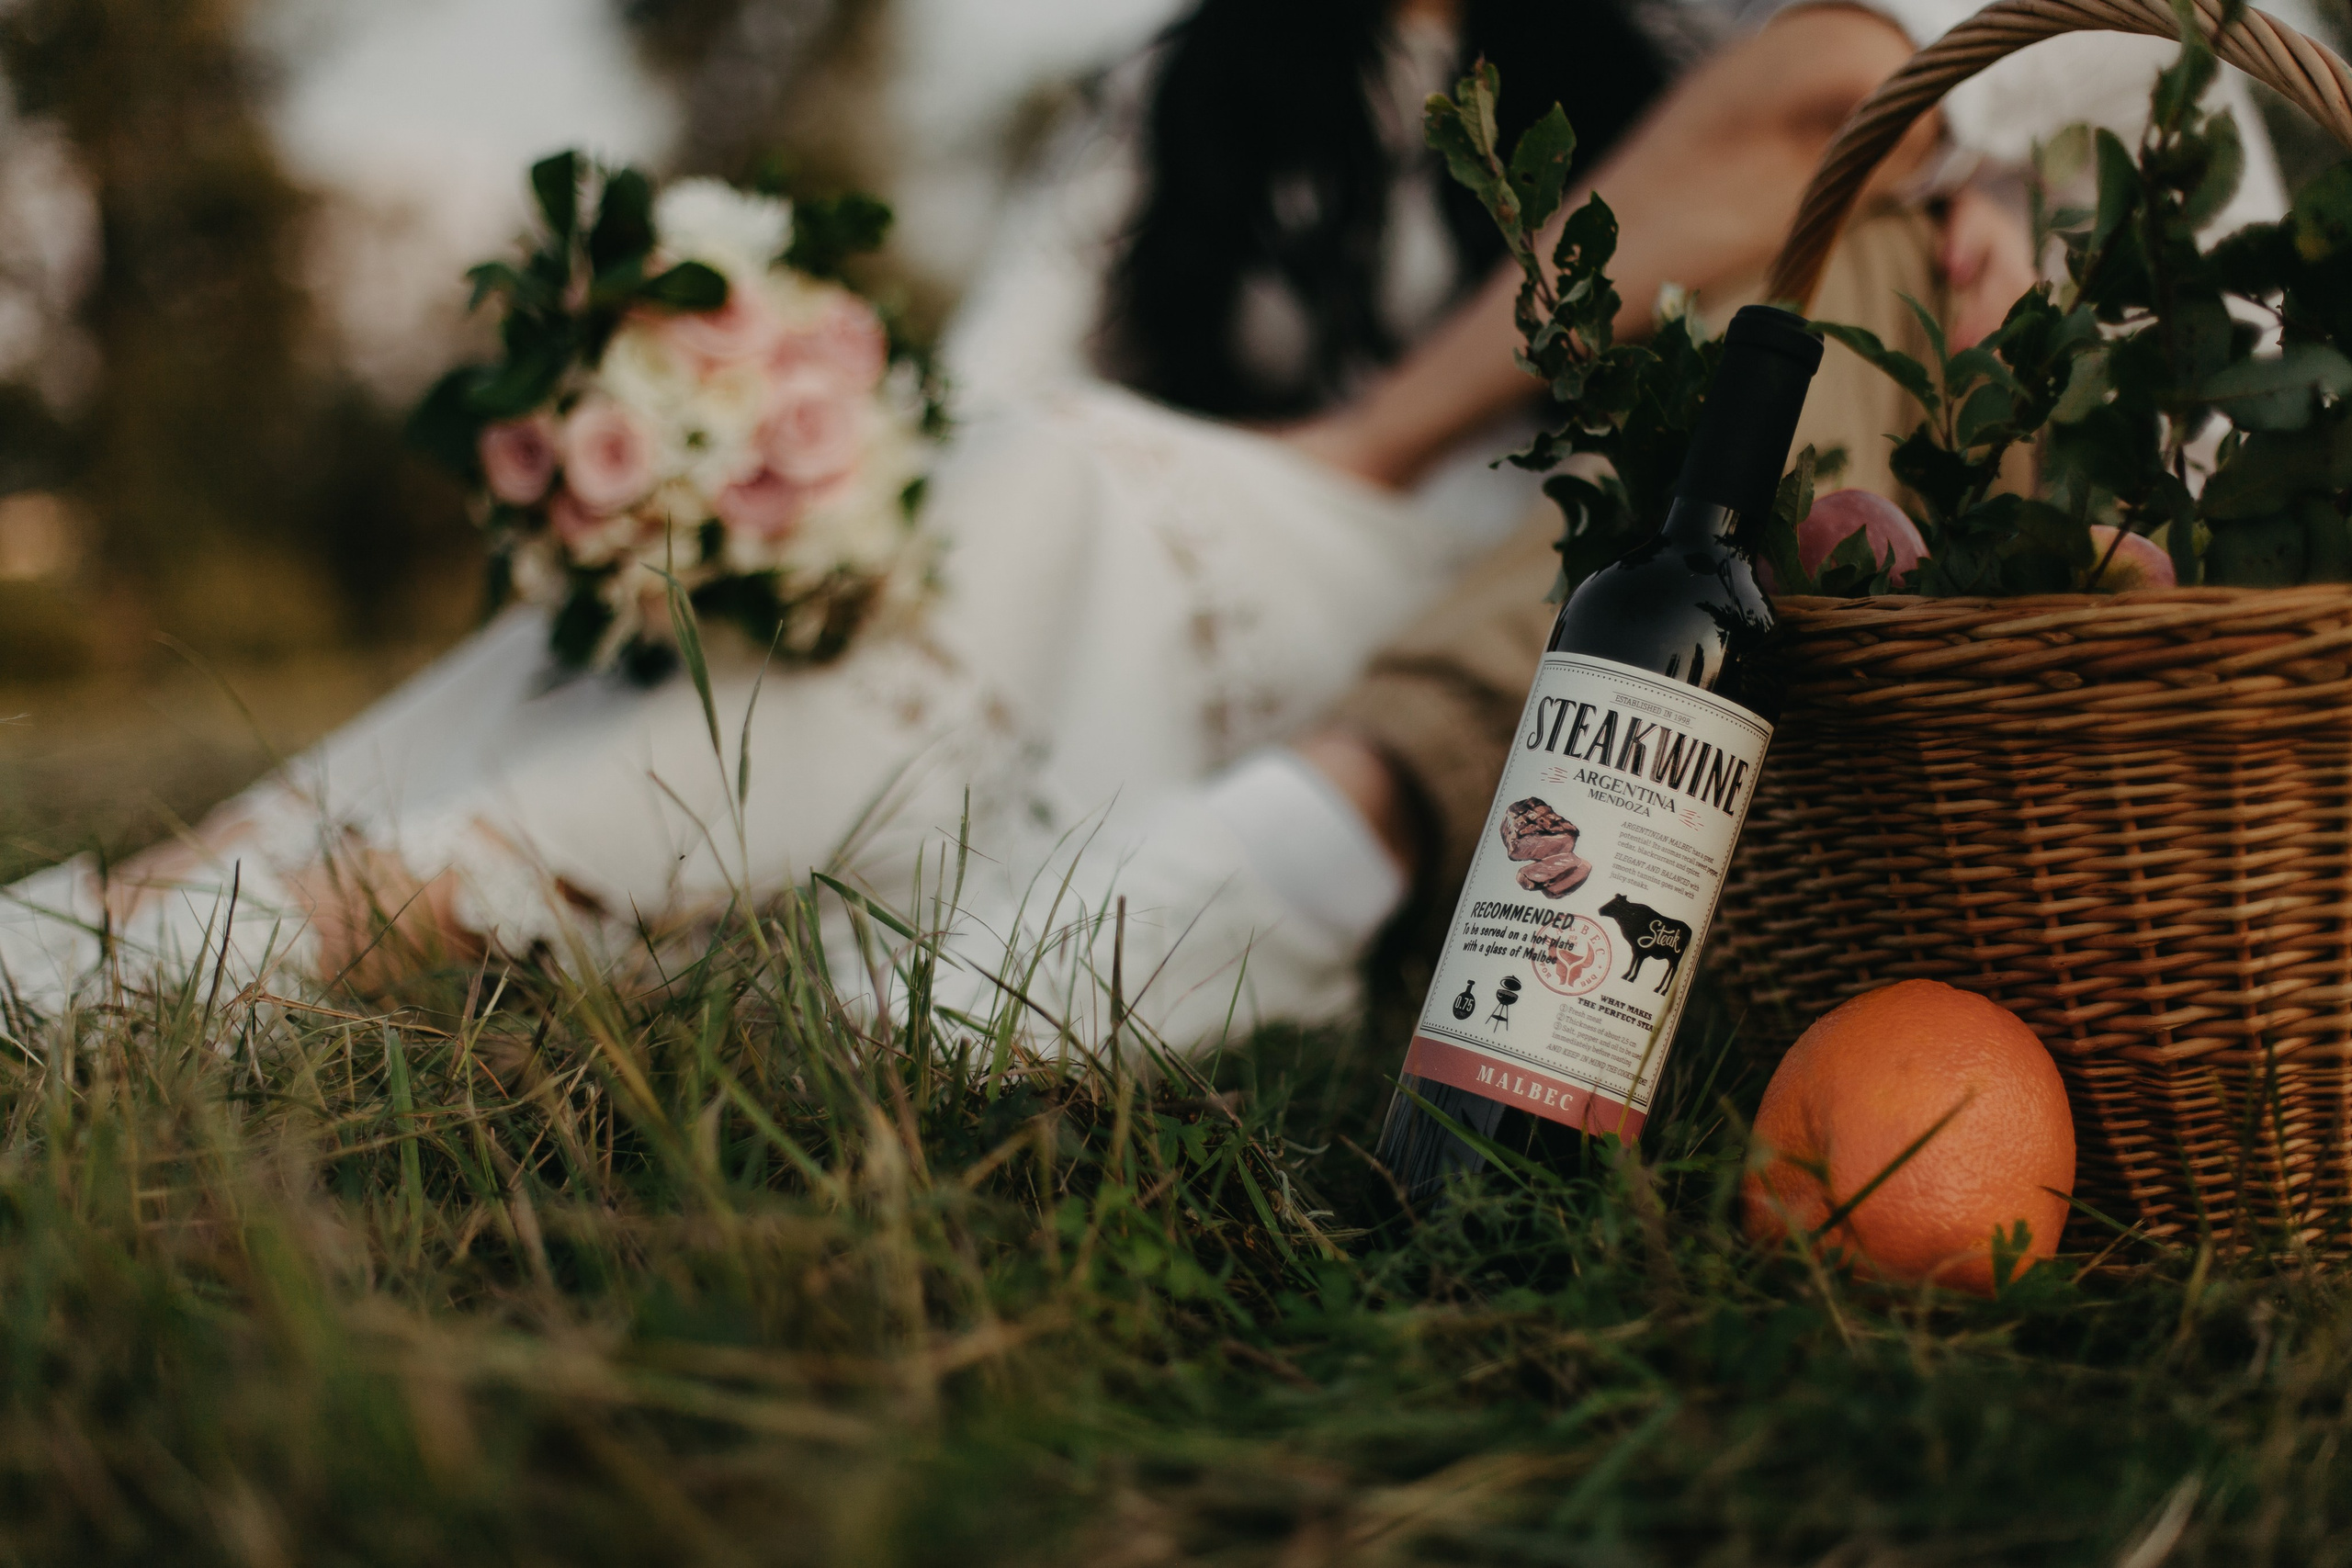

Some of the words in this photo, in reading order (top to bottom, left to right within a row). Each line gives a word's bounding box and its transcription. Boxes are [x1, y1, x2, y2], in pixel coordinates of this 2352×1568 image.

[1615, 694, 1662, 716] ESTABLISHED
[1663, 710, 1672, 718] IN
[1674, 713, 1690, 726] 1998
[1573, 768, 1676, 813] ARGENTINA
[1588, 788, 1651, 818] MENDOZA
[1619, 831, 1652, 847] potential!
[1652, 841, 1661, 851] Its
[1661, 847, 1681, 859] aromas
[1681, 852, 1696, 865] recall
[1621, 821, 1669, 843] ARGENTINIAN
[1668, 838, 1692, 853] MALBEC
[1617, 840, 1635, 852] cedar,
[1637, 846, 1676, 867] blackcurrant
[1676, 861, 1686, 871] and
[1609, 872, 1627, 884] juicy
[1626, 878, 1649, 891] steaks.
[1611, 863, 1636, 876] smooth
[1636, 871, 1661, 885] tannins
[1661, 881, 1673, 890] goes
[1673, 885, 1685, 896] well
[1684, 889, 1695, 900] with
[1613, 852, 1646, 868] ELEGANT
[1645, 863, 1661, 874] AND
[1660, 869, 1690, 886] BALANCED
[1690, 882, 1700, 891] with
[1470, 901, 1575, 930] RECOMMENDED
[1462, 922, 1470, 935] To
[1470, 923, 1478, 935] be
[1480, 926, 1508, 939] served
[1508, 931, 1520, 941] on
[1521, 934, 1528, 942] a
[1530, 931, 1547, 945] hot
[1547, 934, 1575, 952] plate
[1636, 919, 1680, 953] Steak
[1462, 940, 1478, 952] with
[1479, 944, 1484, 953] a
[1484, 942, 1508, 956] glass
[1510, 945, 1522, 957] of
[1522, 948, 1558, 964] Malbec
[1454, 996, 1474, 1011] 0.75
[1567, 1006, 1586, 1020] Fresh
[1586, 1014, 1602, 1024] meat
[1577, 997, 1597, 1010] THE
[1598, 1004, 1636, 1024] PERFECT
[1636, 1020, 1655, 1032] STEA
[1600, 995, 1626, 1010] WHAT
[1627, 1005, 1653, 1021] MAKES
[1566, 1015, 1597, 1032] Thickness
[1604, 1029, 1621, 1041] about
[1577, 1031, 1600, 1045] pepper
[1599, 1039, 1611, 1048] and
[1611, 1043, 1619, 1051] oil
[1624, 1047, 1632, 1055] be
[1545, 1043, 1563, 1054] AND
[1561, 1048, 1580, 1059] KEEP
[1580, 1054, 1589, 1063] IN
[1589, 1057, 1606, 1069] MIND
[1605, 1065, 1618, 1074] THE
[1552, 1032, 1592, 1051] immediately
[1592, 1044, 1611, 1057] before
[1611, 1053, 1633, 1067] roasting
[1476, 1065, 1573, 1111] MALBEC
